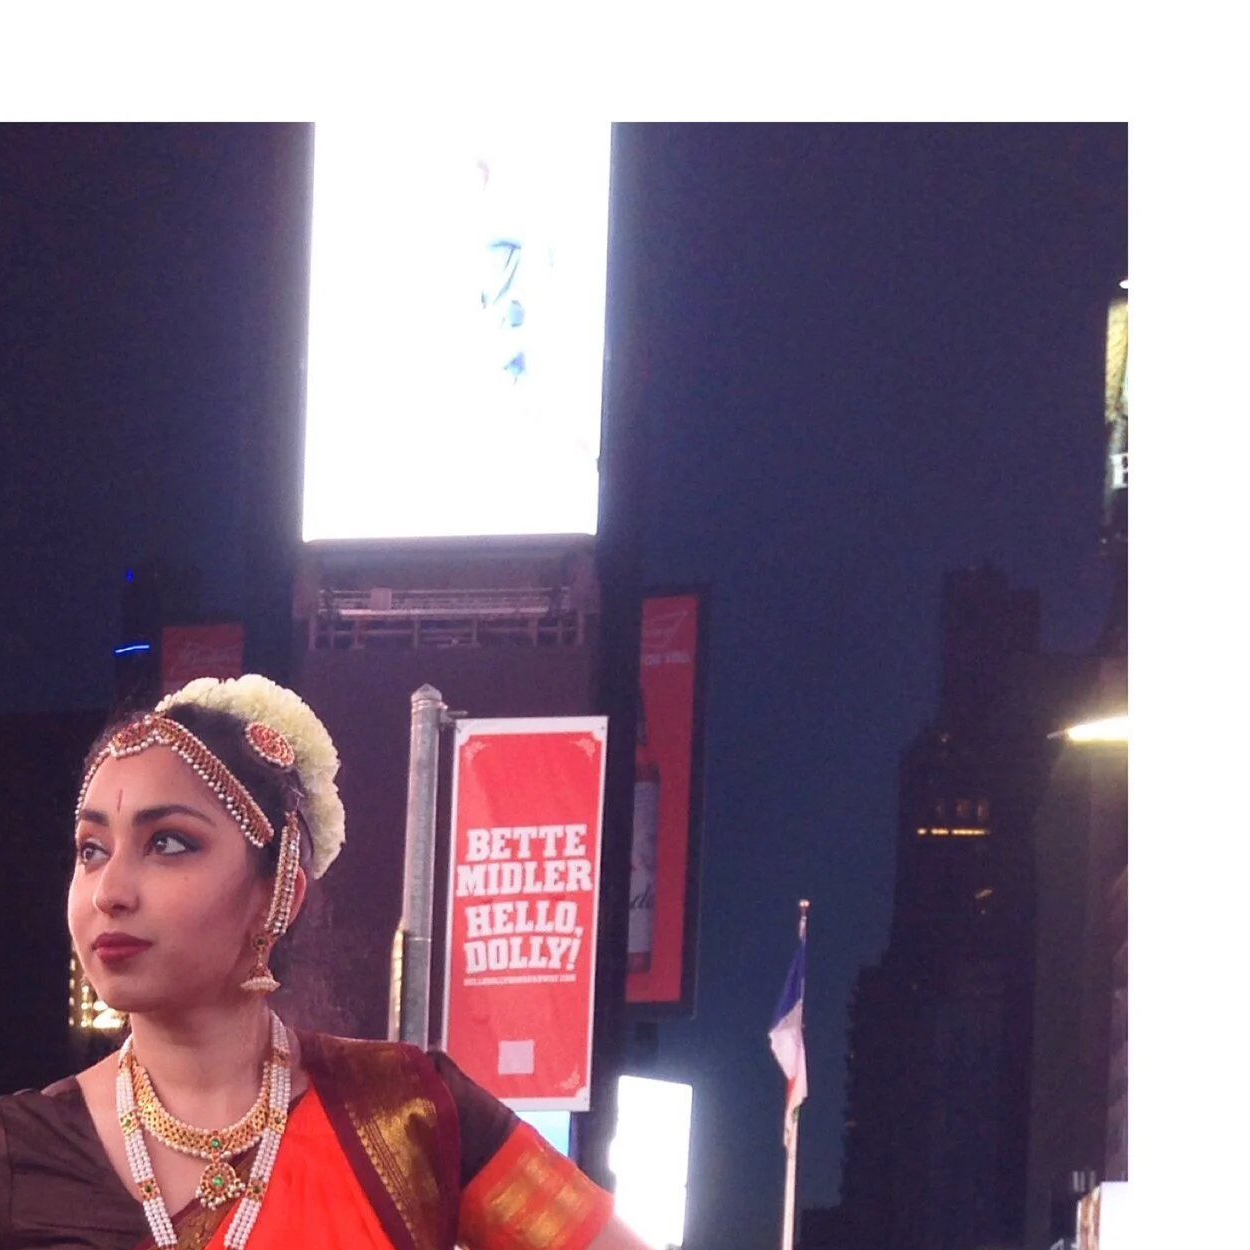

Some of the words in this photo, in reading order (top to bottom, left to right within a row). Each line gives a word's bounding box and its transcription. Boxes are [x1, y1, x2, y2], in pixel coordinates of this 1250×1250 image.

[465, 823, 588, 862] BETTE
[455, 858, 593, 897] MIDLER
[464, 900, 584, 938] HELLO,
[463, 935, 582, 974] DOLLY!
